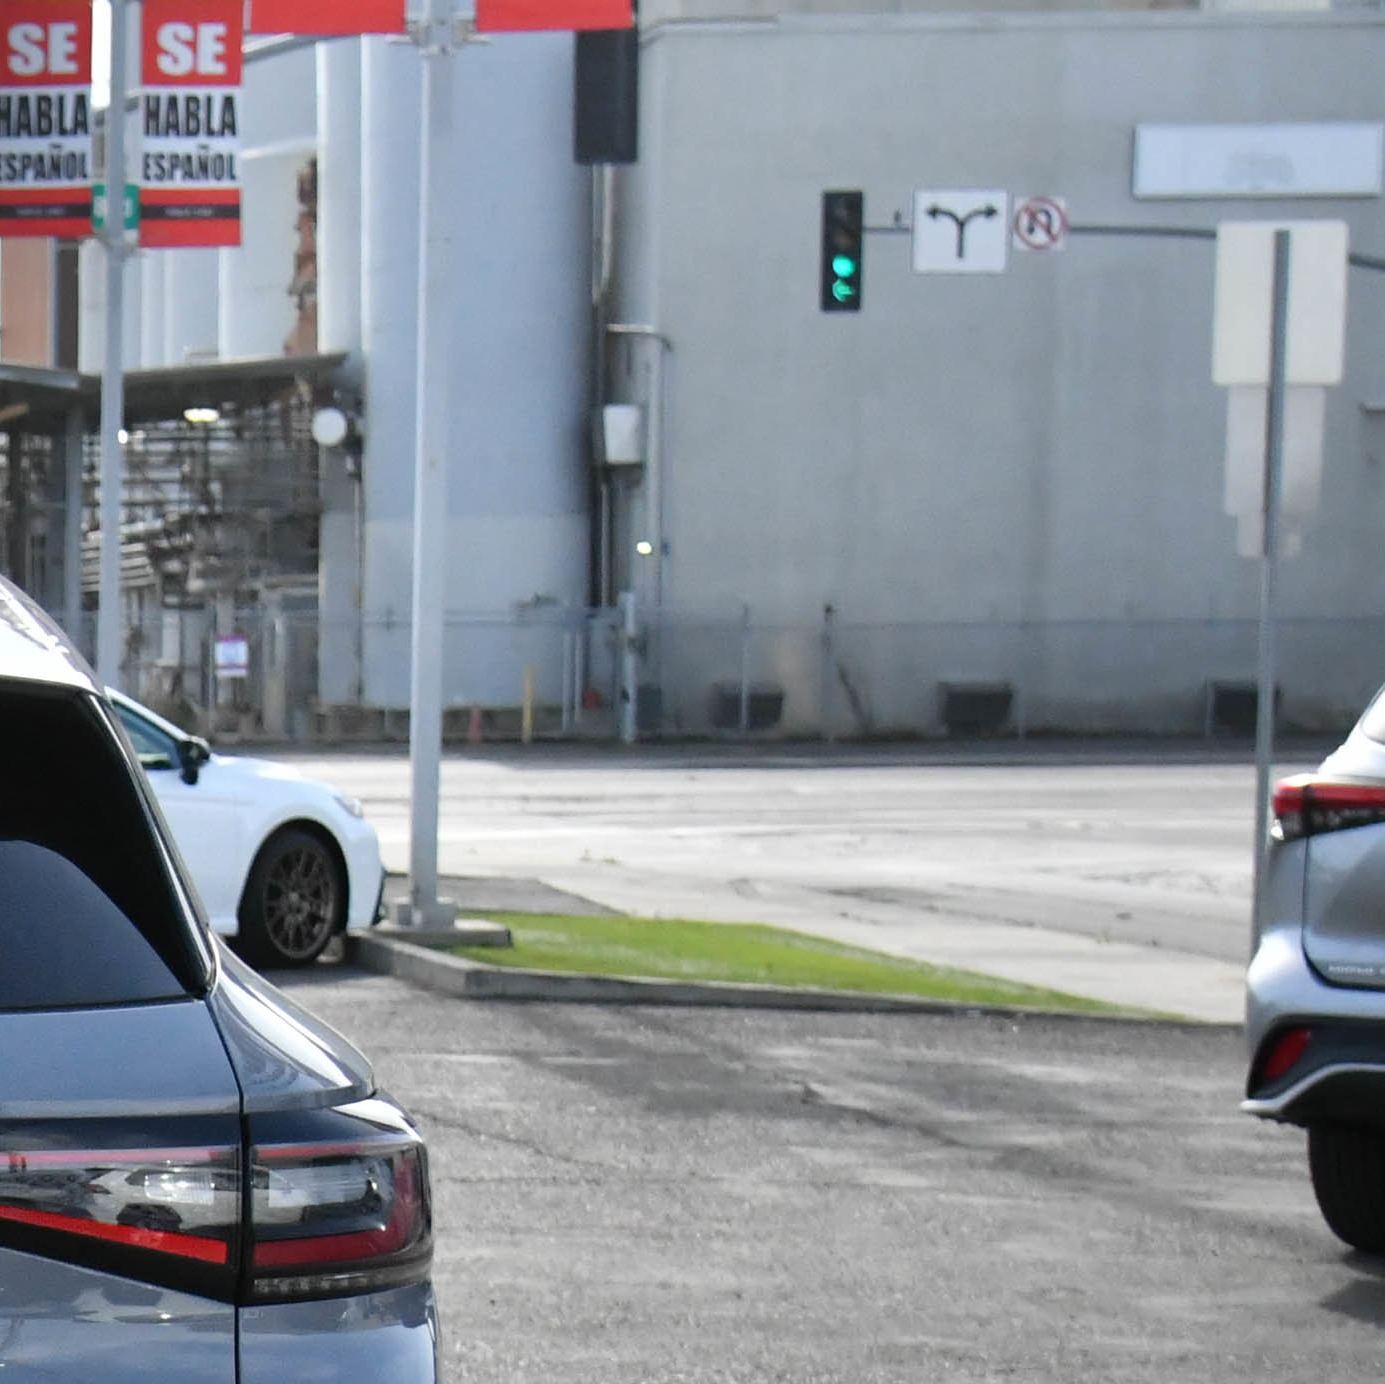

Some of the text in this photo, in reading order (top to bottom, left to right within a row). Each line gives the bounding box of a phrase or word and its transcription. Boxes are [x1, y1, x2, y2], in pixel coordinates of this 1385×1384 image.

[7, 22, 78, 76] SE
[156, 22, 227, 76] SE
[144, 94, 237, 137] HABLA
[143, 143, 236, 182] ESPAÑOL
